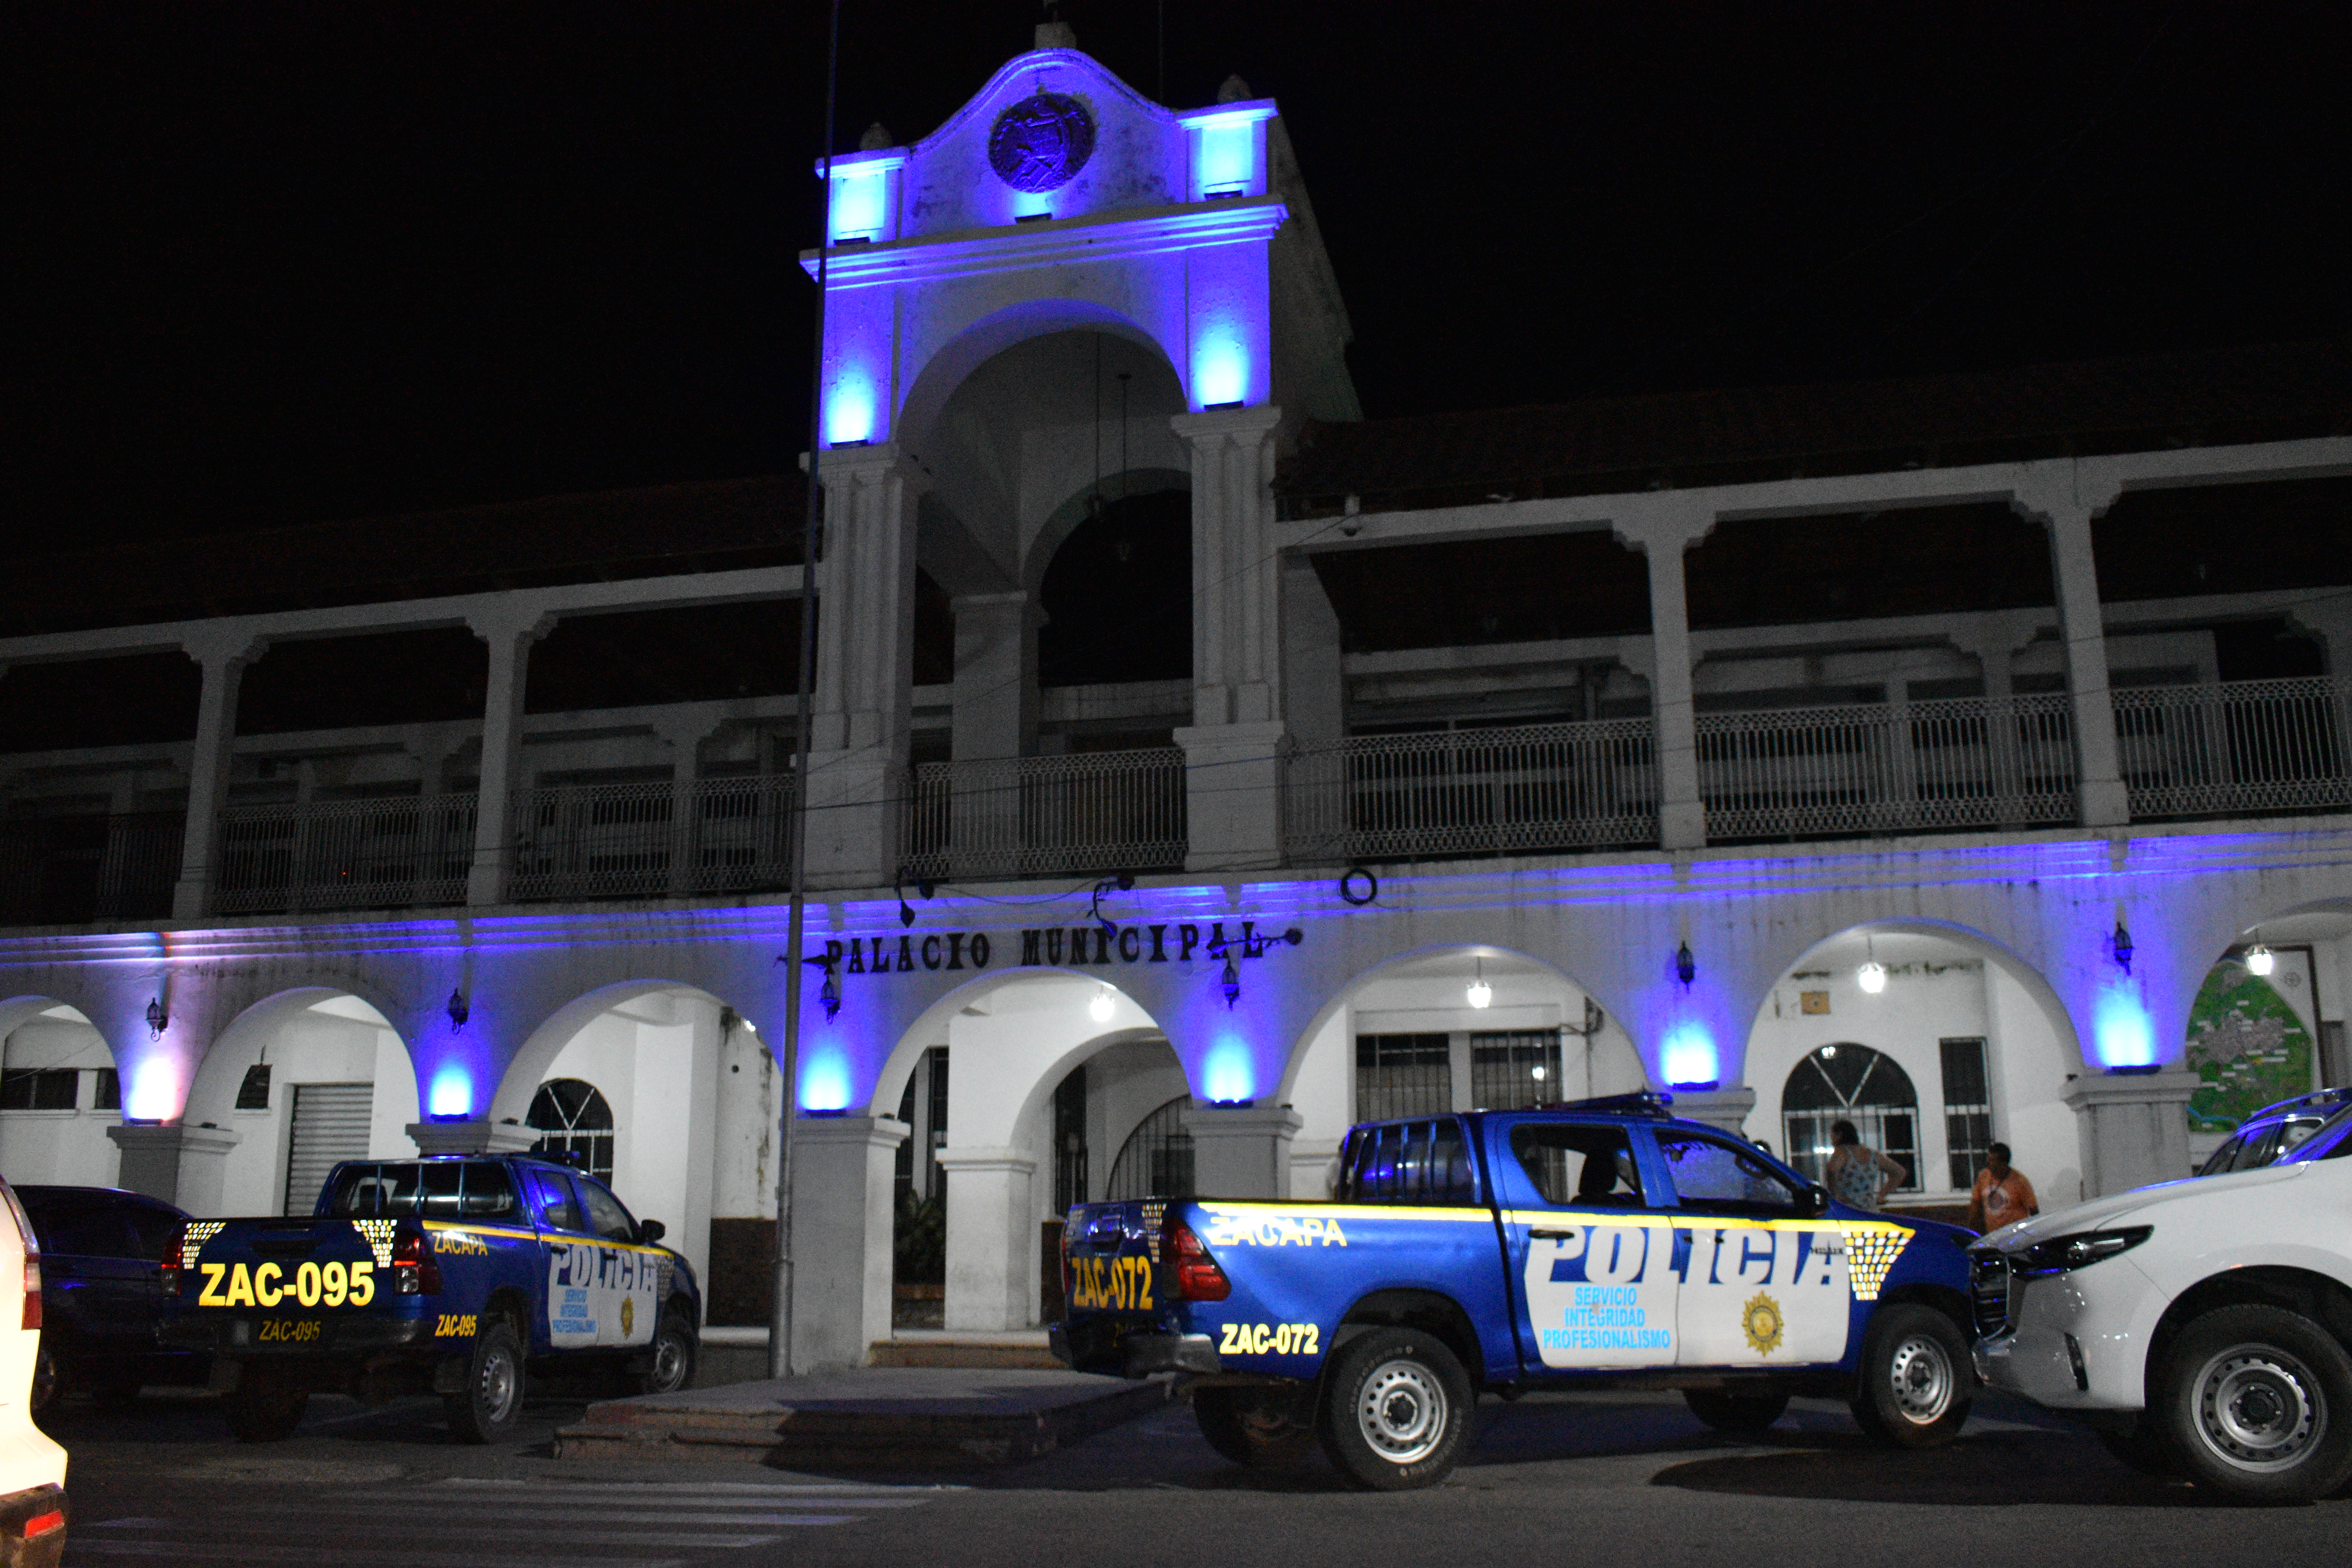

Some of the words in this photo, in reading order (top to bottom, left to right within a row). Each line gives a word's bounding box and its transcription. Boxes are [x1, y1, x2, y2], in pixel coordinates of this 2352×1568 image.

[824, 932, 990, 975] PALACIO
[1020, 921, 1263, 966] MUNICIPAL
[432, 1232, 488, 1256] ZACAPA
[1210, 1216, 1348, 1247] ZACAPA
[549, 1242, 658, 1291] POLICIA
[1524, 1223, 1849, 1285] POLICIA
[199, 1261, 375, 1307] ZAC-095
[1071, 1256, 1153, 1310] ZAC-072
[1573, 1286, 1637, 1306] SERVICIO
[259, 1319, 321, 1341] ZAC-095
[435, 1314, 477, 1337] ZAC-095
[1564, 1306, 1645, 1327] INTEGRIDAD
[1219, 1323, 1319, 1354] ZAC-072
[1542, 1327, 1671, 1349] PROFESIONALISMO
